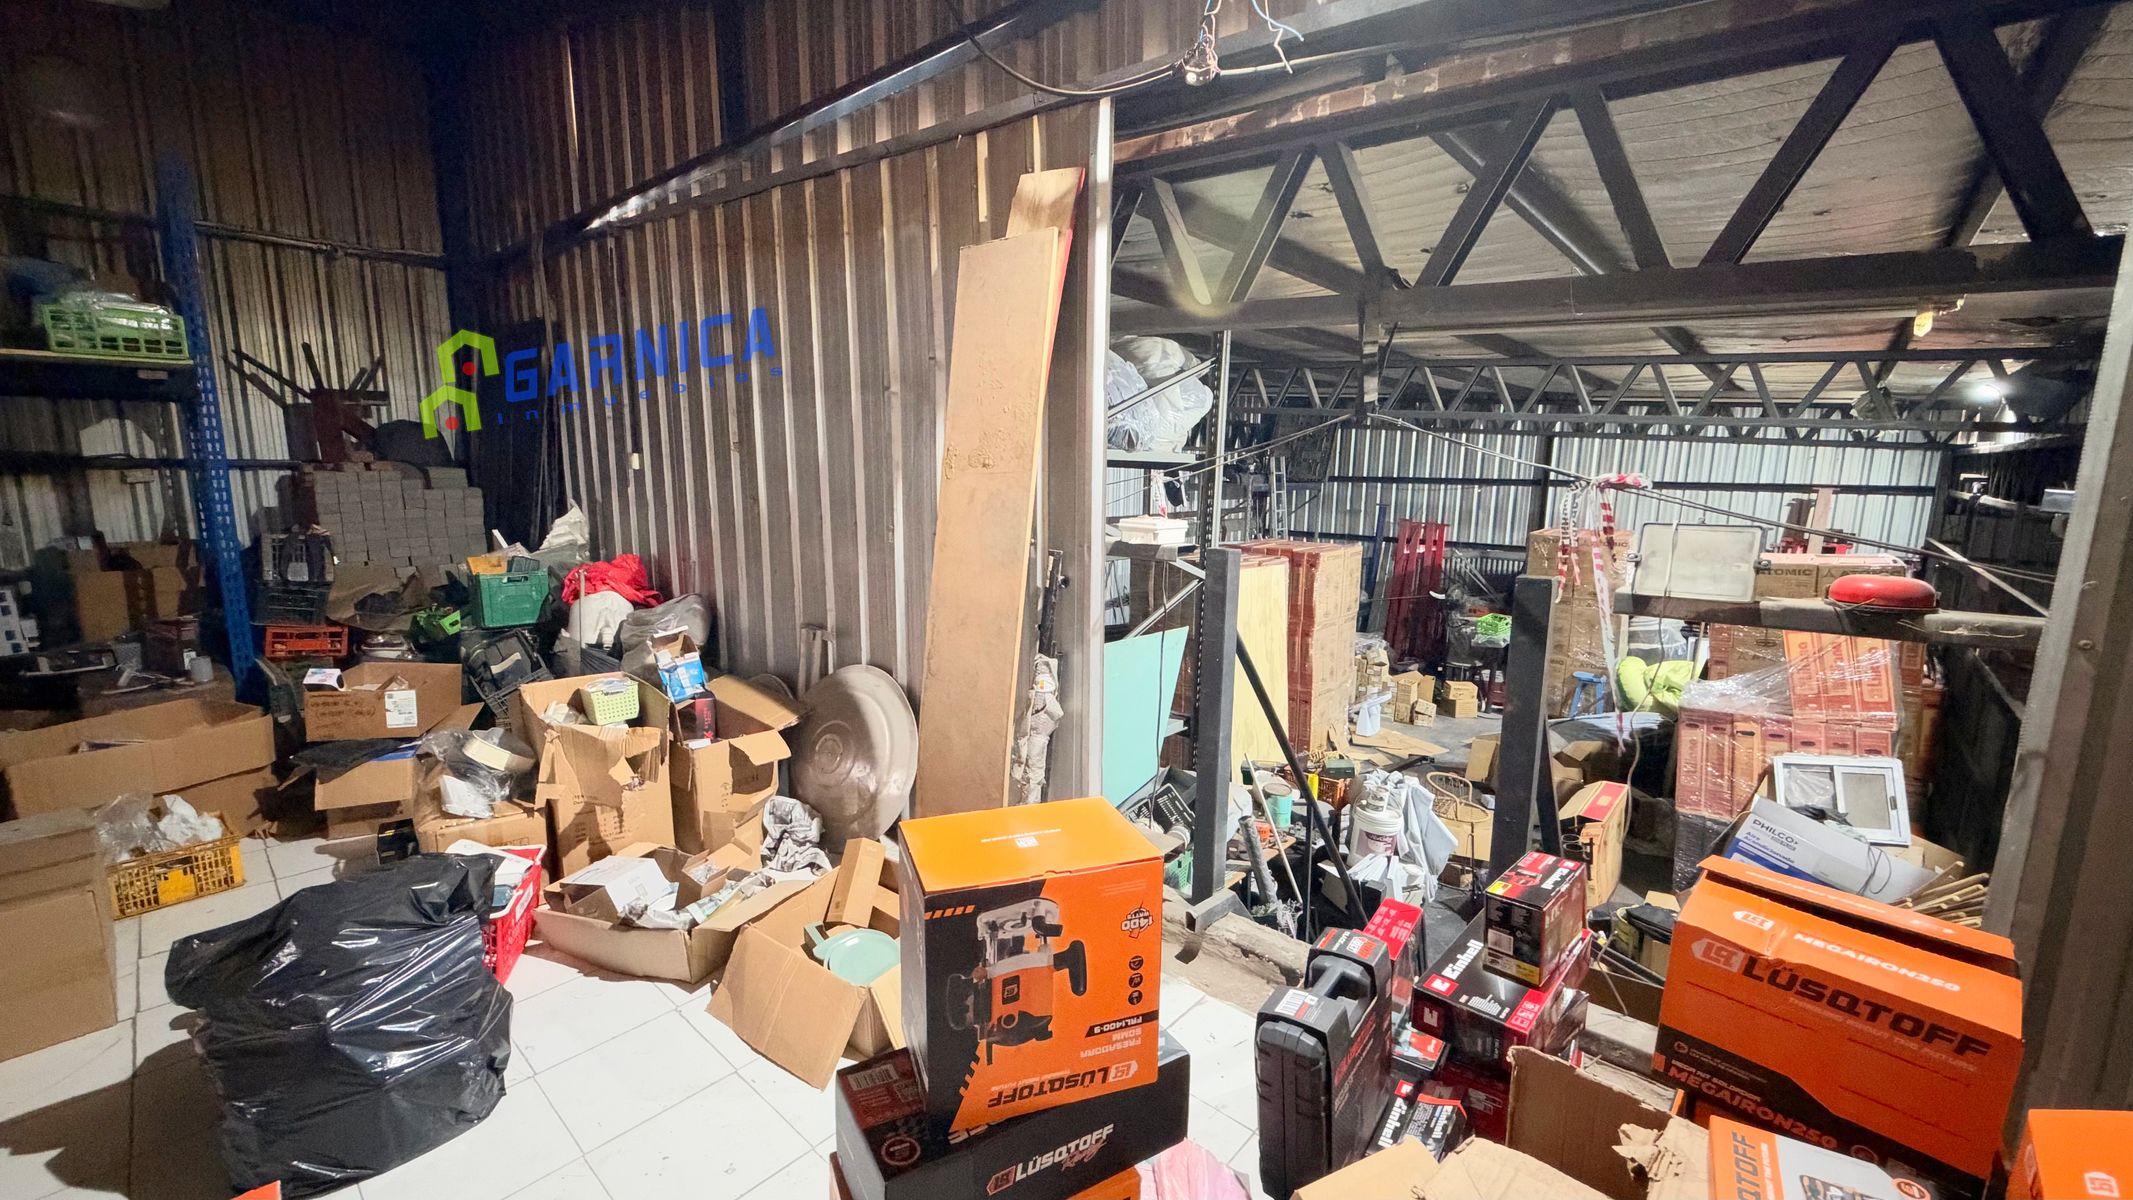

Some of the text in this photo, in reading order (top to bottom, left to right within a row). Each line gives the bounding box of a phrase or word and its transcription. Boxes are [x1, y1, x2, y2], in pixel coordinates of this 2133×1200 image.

[1752, 818, 1794, 843] PHILCO
[1121, 914, 1154, 932] 1400
[1441, 939, 1484, 980] Einhell
[1793, 932, 1961, 992] MEGAIRON250
[1741, 953, 1994, 1057] LÜSQTOFF
[1080, 1037, 1142, 1058] FRESADORA
[987, 1065, 1110, 1108] LÜSQTOFF
[1668, 1065, 1838, 1149] MEGAIRON250
[1378, 1097, 1408, 1148] Einhell
[1015, 1123, 1114, 1182] LÜSQTOFF
